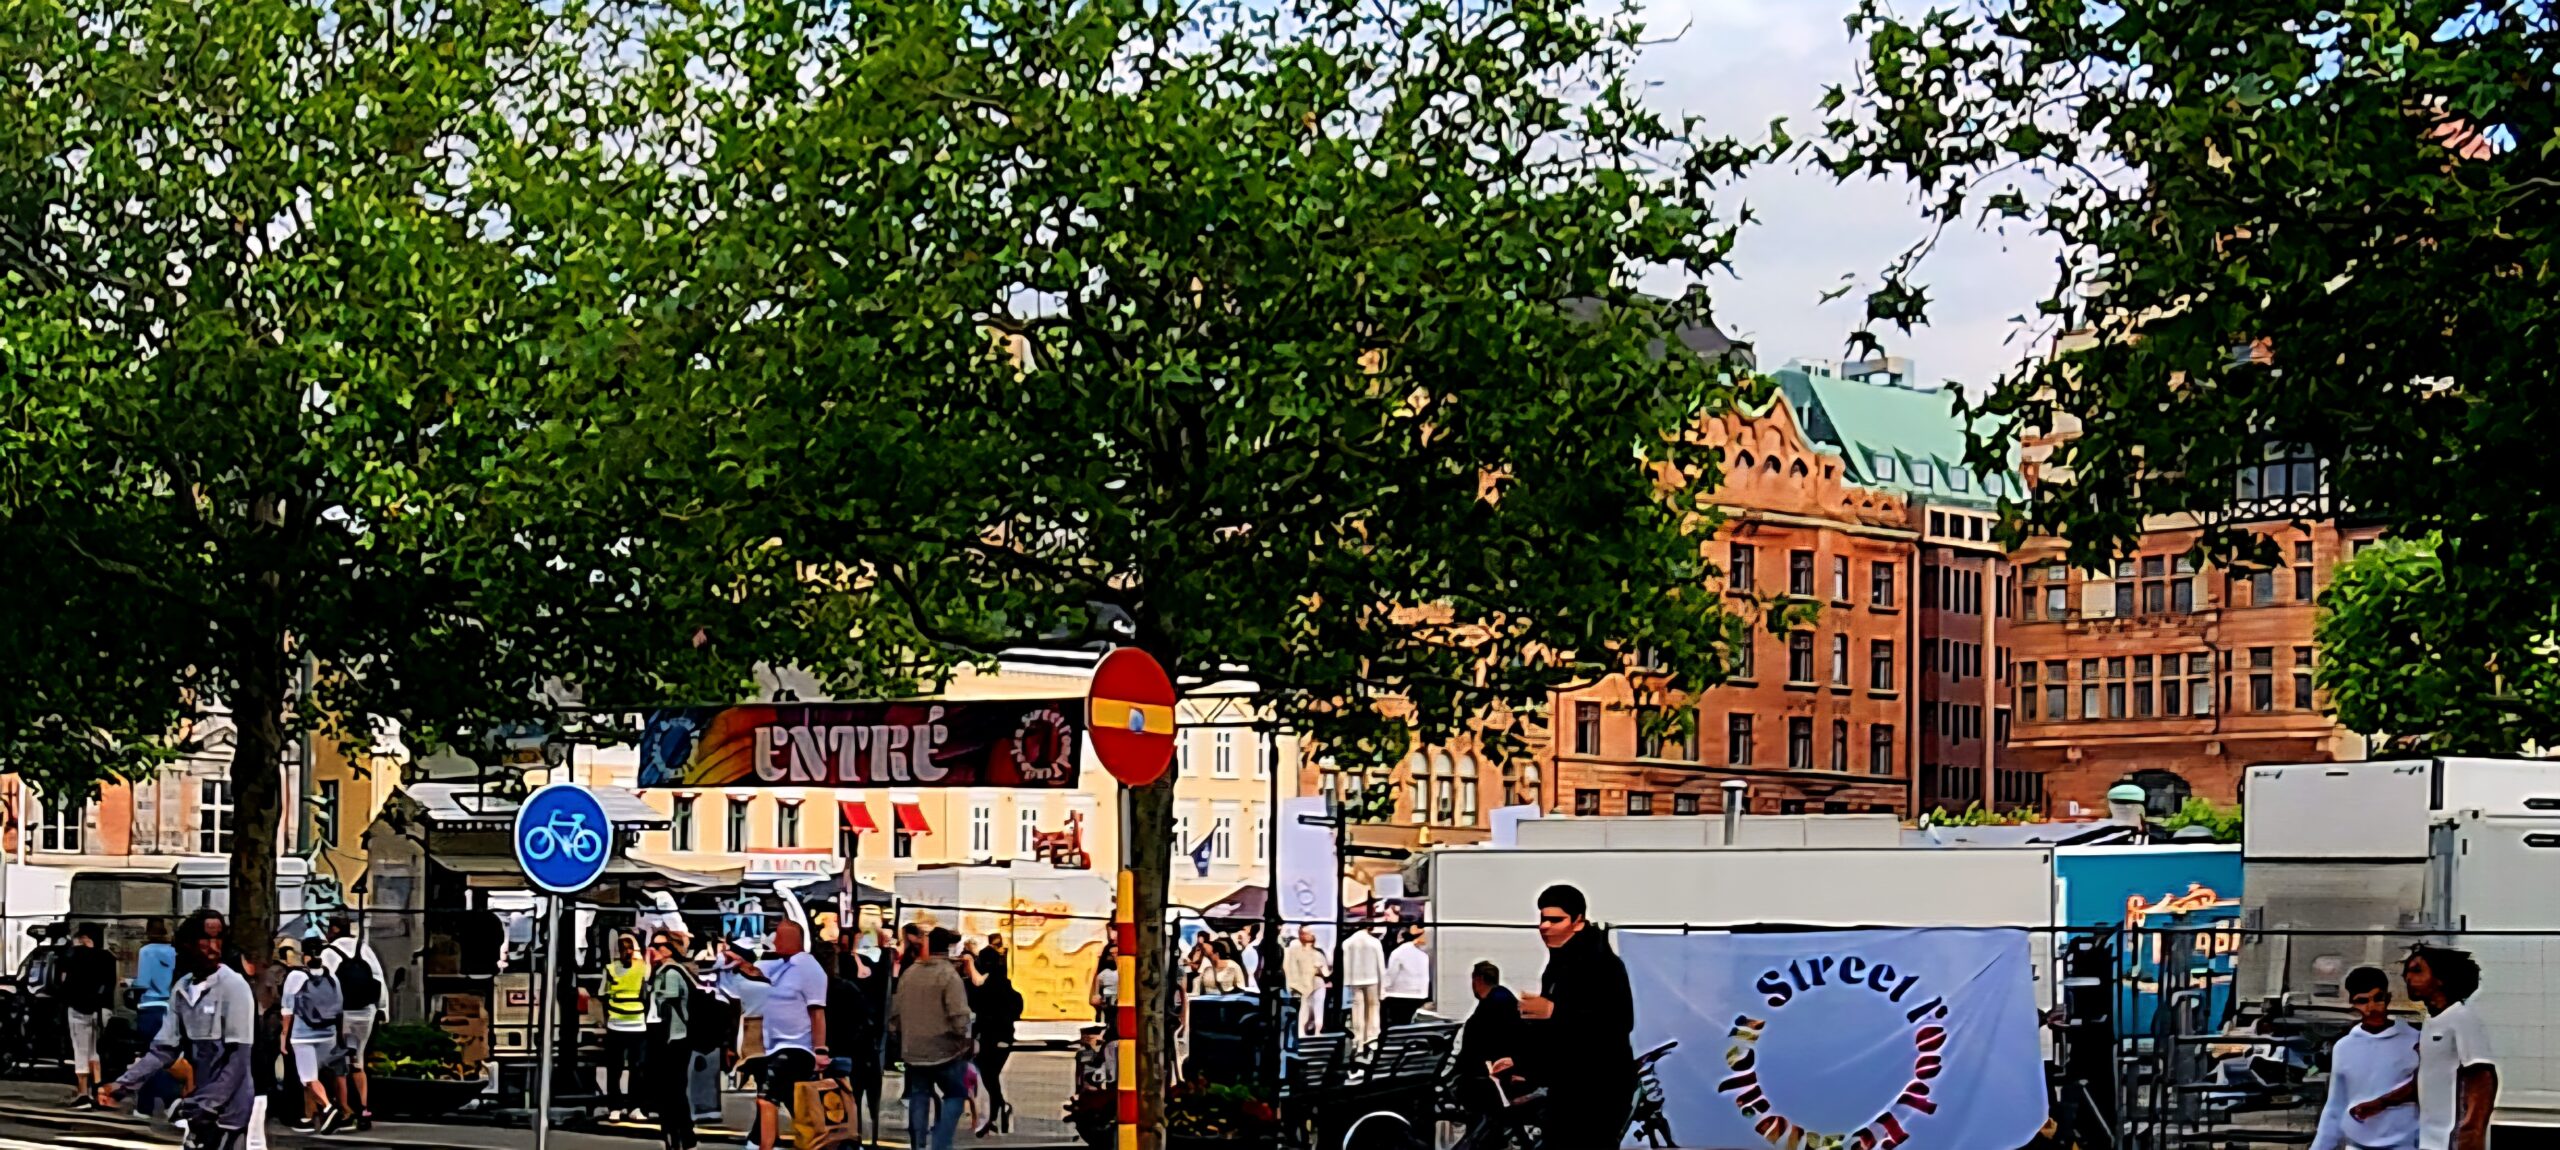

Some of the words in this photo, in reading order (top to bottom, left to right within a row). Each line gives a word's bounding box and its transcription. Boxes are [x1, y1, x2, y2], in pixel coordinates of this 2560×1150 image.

[755, 705, 949, 781] ENTRÉ
[1756, 955, 1920, 1008] Street
[1896, 995, 1949, 1116] Food
